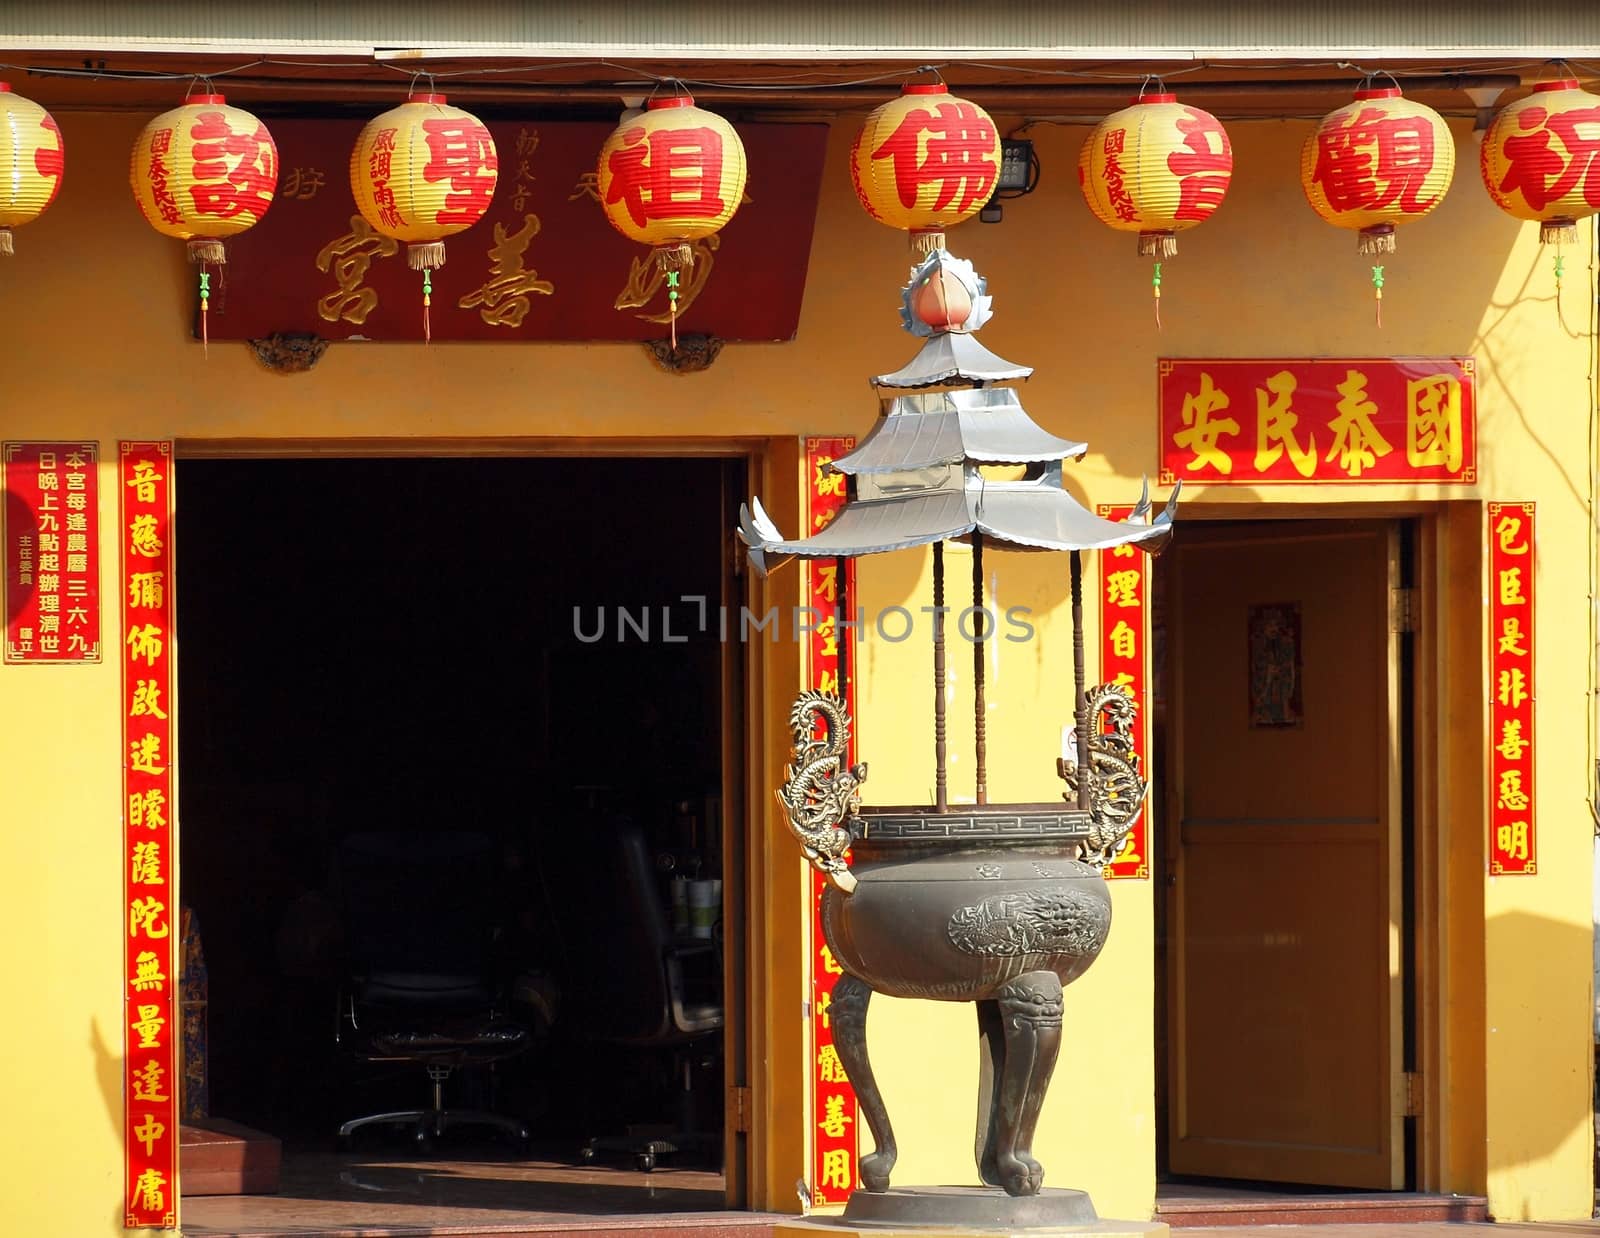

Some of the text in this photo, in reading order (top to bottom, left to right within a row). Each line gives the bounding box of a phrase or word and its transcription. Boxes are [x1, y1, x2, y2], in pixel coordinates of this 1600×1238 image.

[148, 118, 186, 225] 國泰民安
[369, 127, 408, 229] 風調雨順
[422, 118, 497, 224] 聖
[607, 127, 724, 228] 祖
[871, 103, 997, 213] 佛
[1102, 128, 1143, 223] 國泰民安
[1312, 108, 1441, 213] 觀
[1500, 106, 1600, 211] 祝
[1172, 369, 1463, 478] 國泰民安
[18, 534, 33, 586] 主任委員
[37, 451, 61, 654] 日晚上九點起辦理濟世
